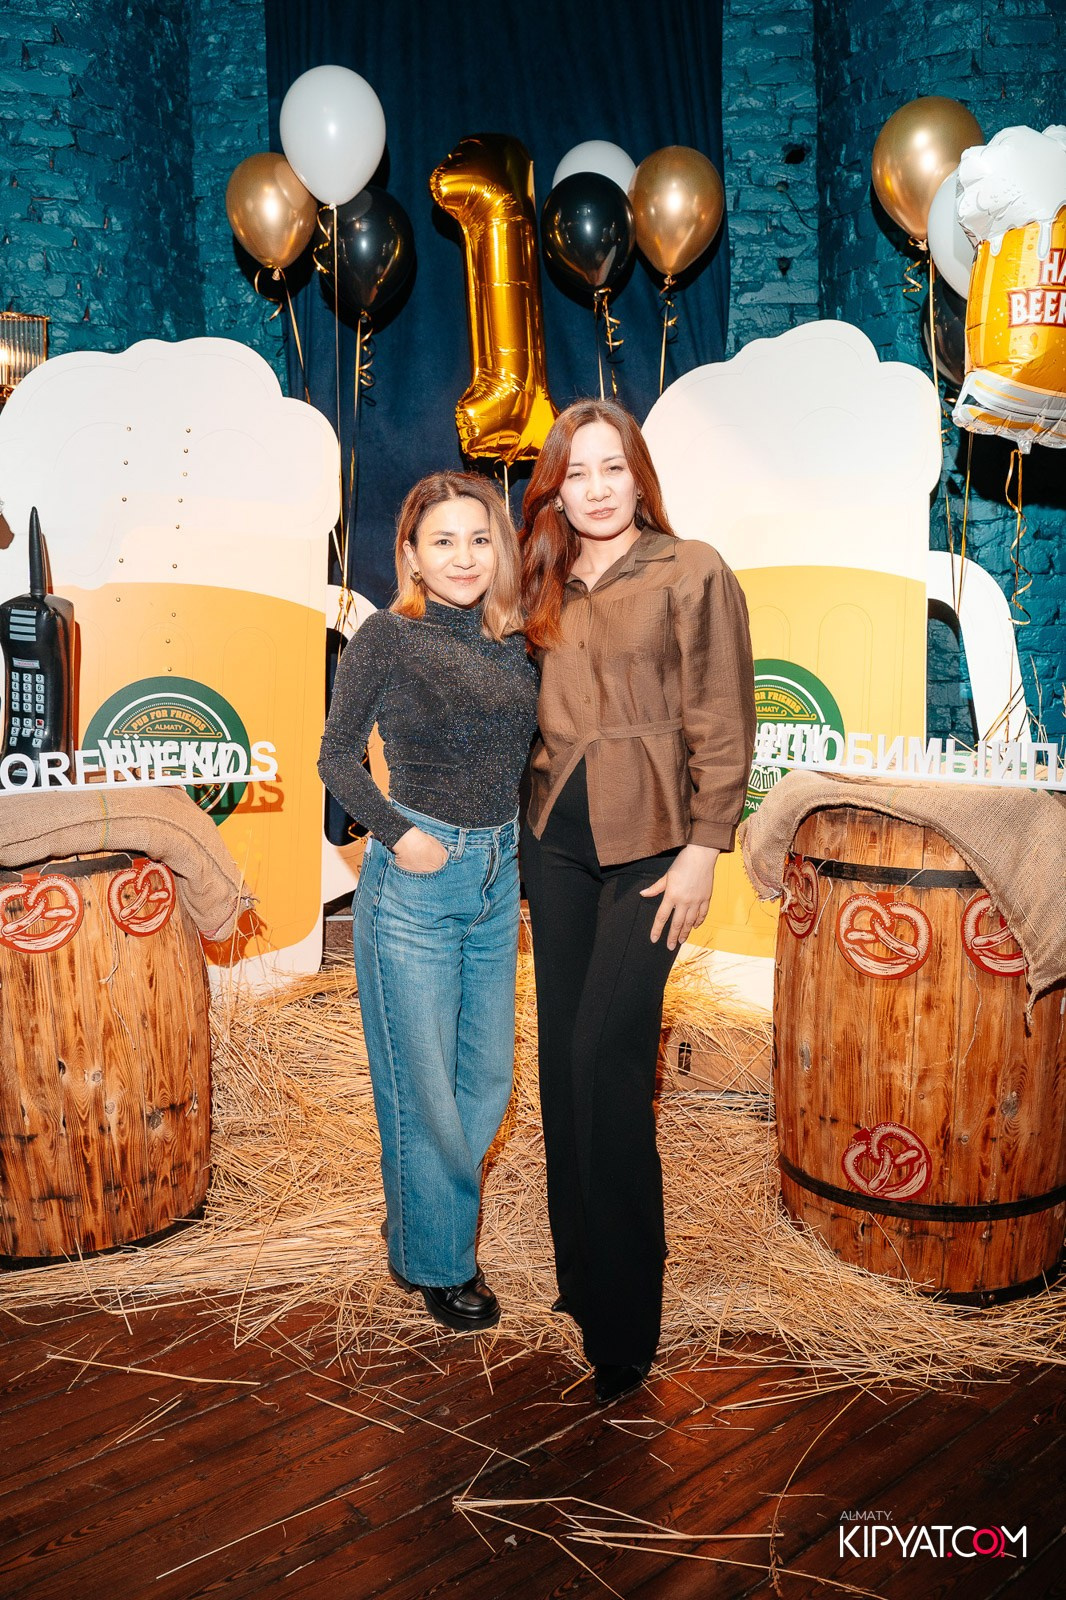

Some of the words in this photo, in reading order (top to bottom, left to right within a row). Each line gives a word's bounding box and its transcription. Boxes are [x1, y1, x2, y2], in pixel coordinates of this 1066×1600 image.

[430, 133, 559, 466] 1
[131, 715, 149, 730] PUB
[150, 710, 168, 719] FOR
[170, 710, 206, 731] FRIENDS
[768, 692, 801, 713] FRIENDS
[754, 728, 1066, 783] #ЛЮБИМЫЙП
